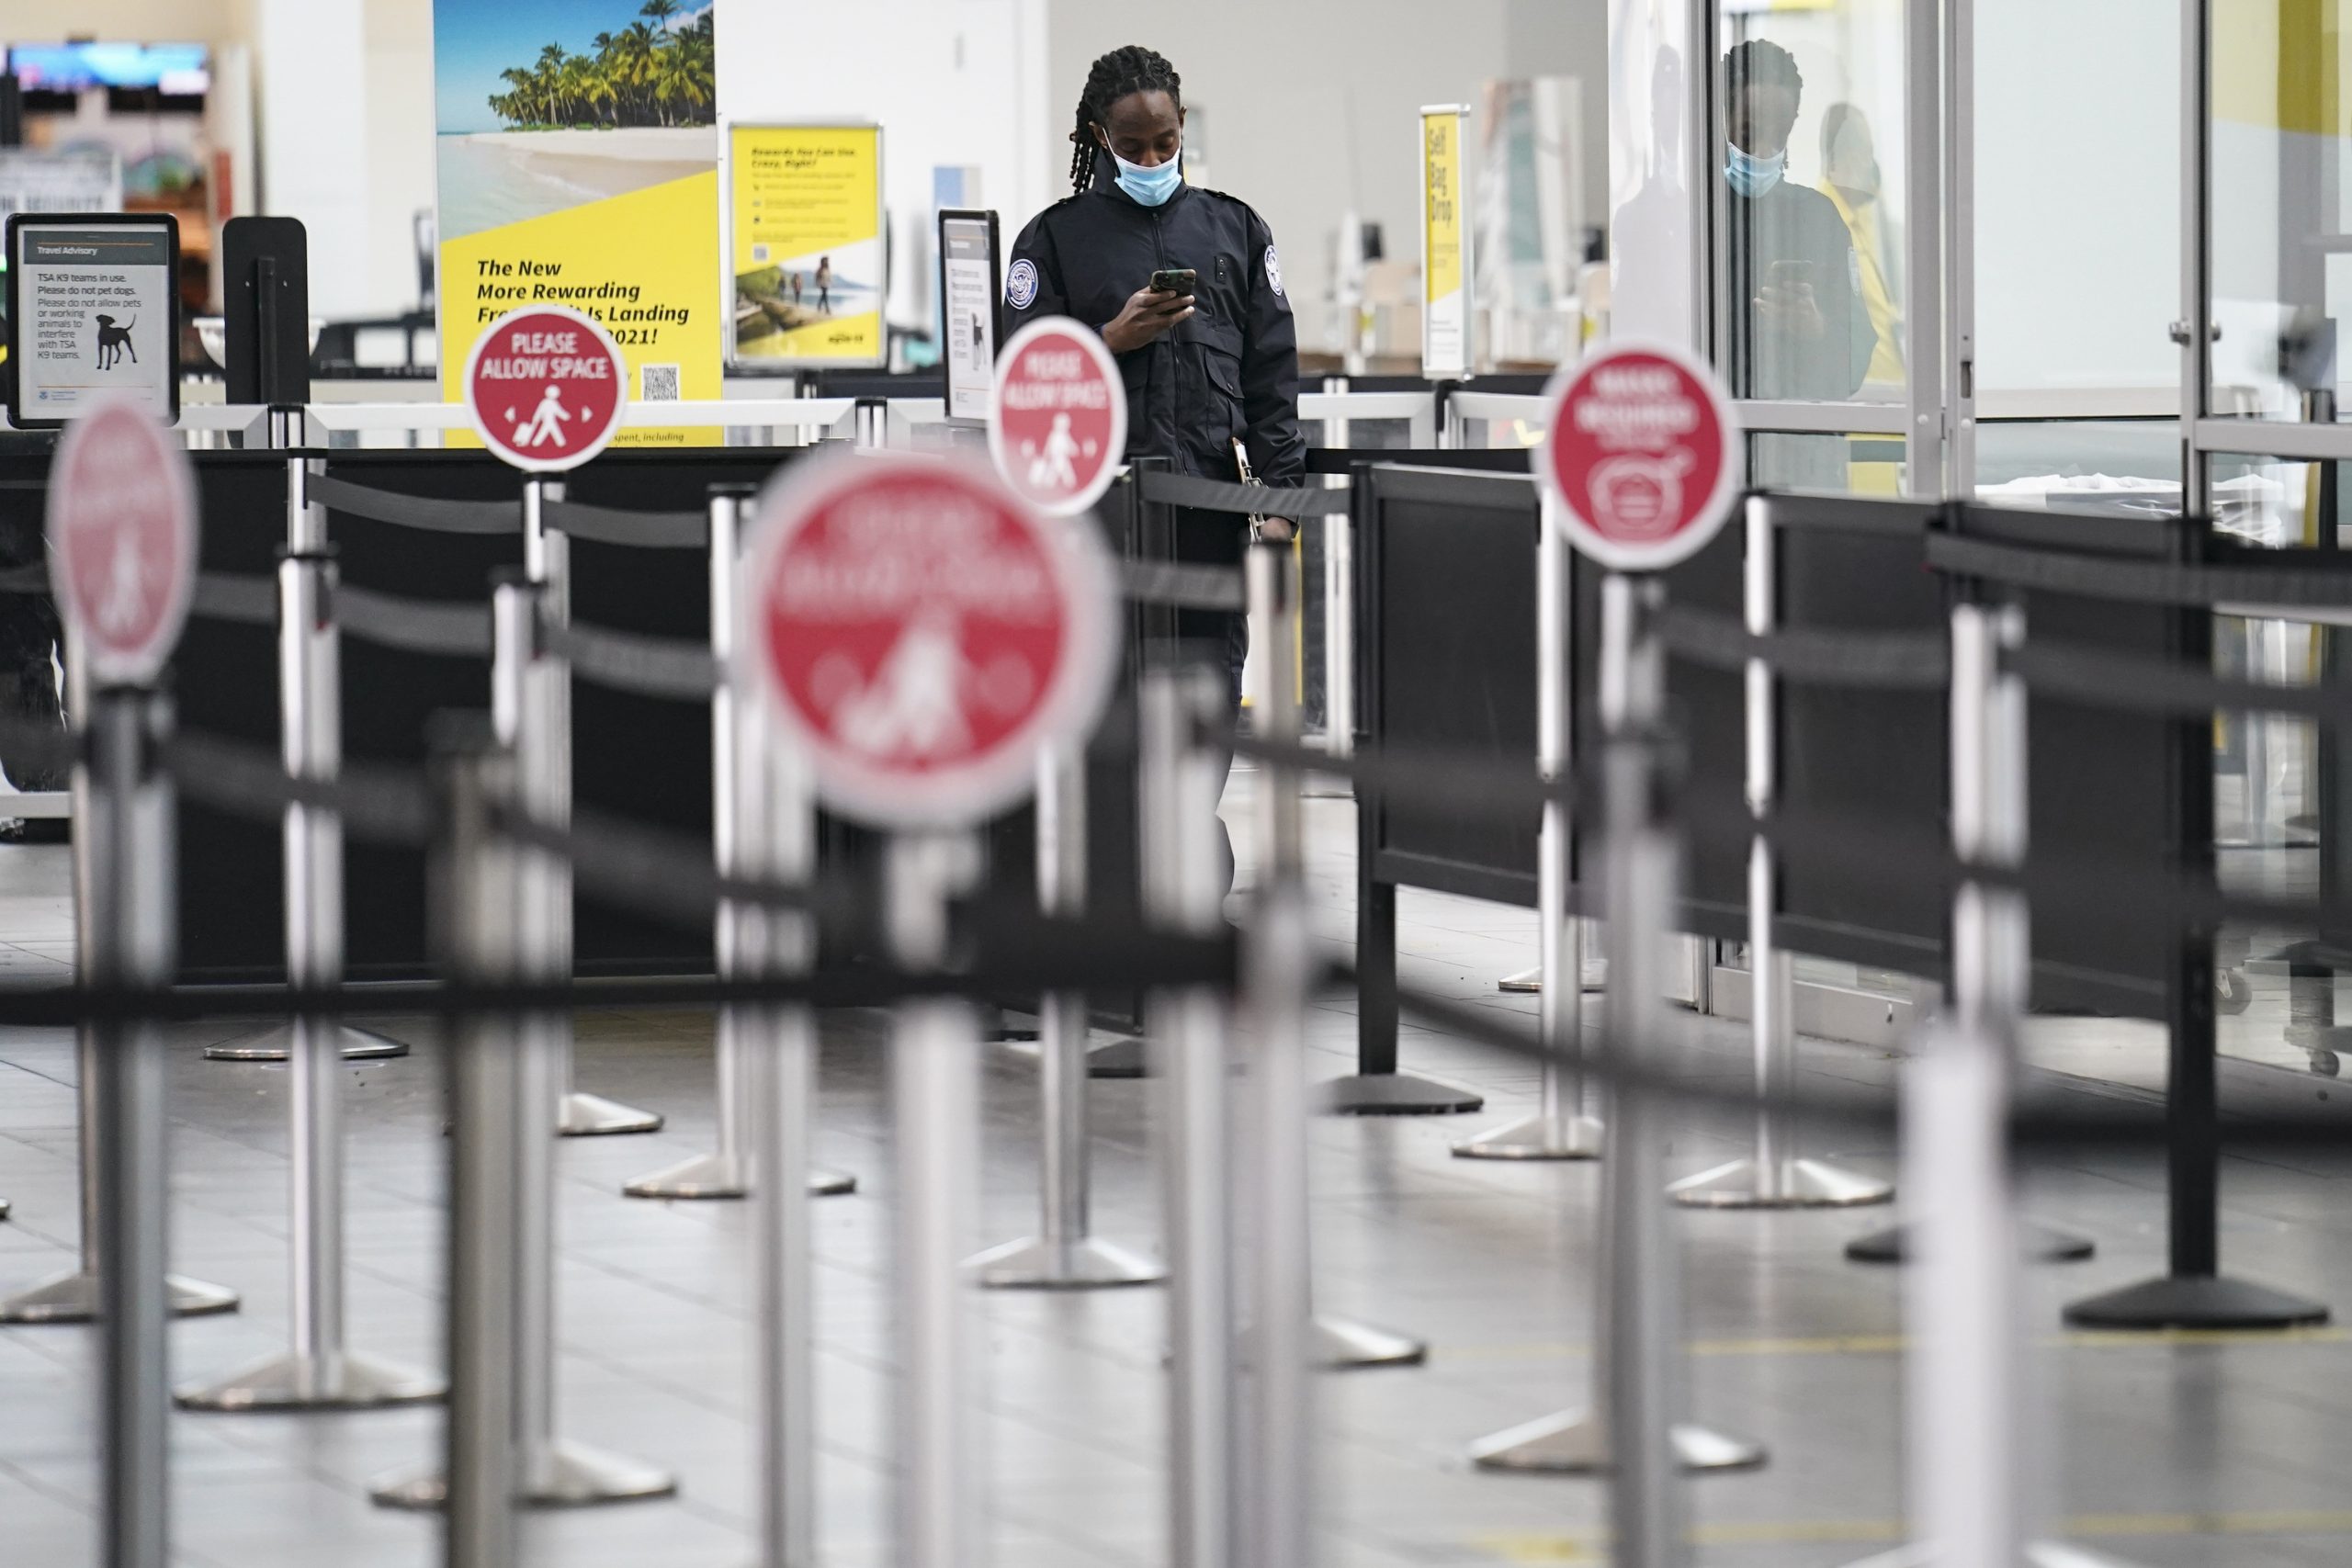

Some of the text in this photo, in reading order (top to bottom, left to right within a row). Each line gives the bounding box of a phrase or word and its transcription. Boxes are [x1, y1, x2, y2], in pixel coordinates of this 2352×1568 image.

[37, 246, 98, 256] Travel Advisory
[477, 259, 562, 276] The New
[38, 274, 54, 282] TSA
[56, 274, 69, 282] K9
[71, 274, 97, 282] teams
[99, 274, 107, 282] in
[38, 286, 136, 297] Please do not pet dogs.
[477, 281, 640, 303] More Rewarding
[38, 299, 141, 309] Please do not allow pets
[50, 310, 85, 319] working
[608, 304, 689, 325] Landing
[38, 320, 72, 328] animals
[38, 330, 75, 338] interfere
[38, 340, 76, 349] with TSA
[511, 332, 578, 355] PLEASE
[38, 351, 51, 359] K9
[480, 358, 547, 379] ALLOW
[550, 357, 609, 379] SPACE
[614, 433, 684, 443] spent, including
